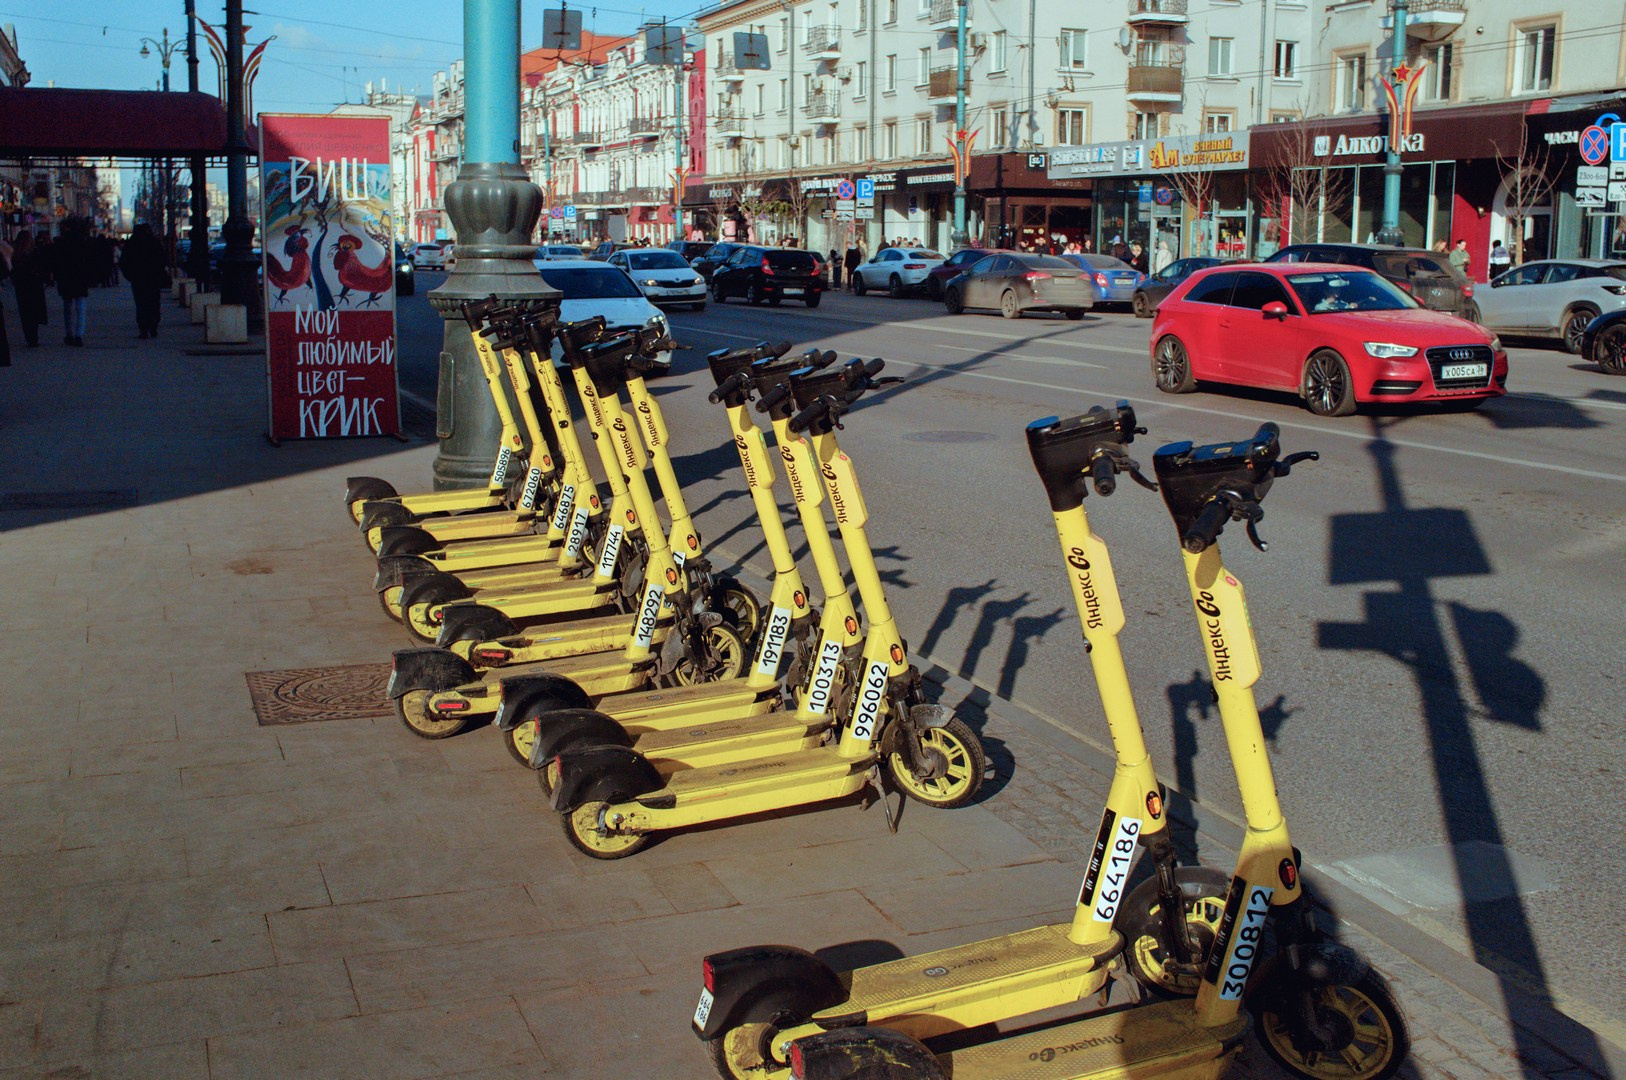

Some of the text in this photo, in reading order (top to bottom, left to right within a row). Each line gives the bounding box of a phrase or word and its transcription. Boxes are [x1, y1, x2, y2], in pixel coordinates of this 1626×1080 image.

[1181, 150, 1245, 165] СУПЕРМАРКЕТ
[1194, 136, 1232, 152] ВИННЫЙ
[1333, 133, 1424, 156] Алкотка
[288, 156, 369, 202] ВИШ
[295, 304, 339, 335] Мой
[297, 336, 394, 365] любимый
[299, 395, 385, 438] КРИК
[583, 385, 603, 427] Яндекс Go
[638, 401, 660, 447] Яндекс Go
[613, 417, 636, 468] Яндекс Go
[736, 434, 758, 487] Яндекс Go
[494, 448, 510, 484] 505896
[521, 468, 541, 510] 672060
[781, 446, 805, 503] Яндекс Go
[554, 485, 574, 529] 646875
[821, 463, 848, 524] Яндекс Go
[568, 513, 587, 553] 28917
[601, 531, 621, 569] 117744
[1068, 547, 1103, 629] Яндекс Go
[638, 589, 663, 641] 148292
[1195, 591, 1232, 682] Яндекс Go
[763, 614, 788, 667] 191183
[810, 643, 839, 711] 100313
[855, 664, 888, 737] 996062
[1096, 821, 1139, 920] 664186
[1222, 889, 1273, 998] 300812
[1029, 1034, 1125, 1063] Яндекс Go
